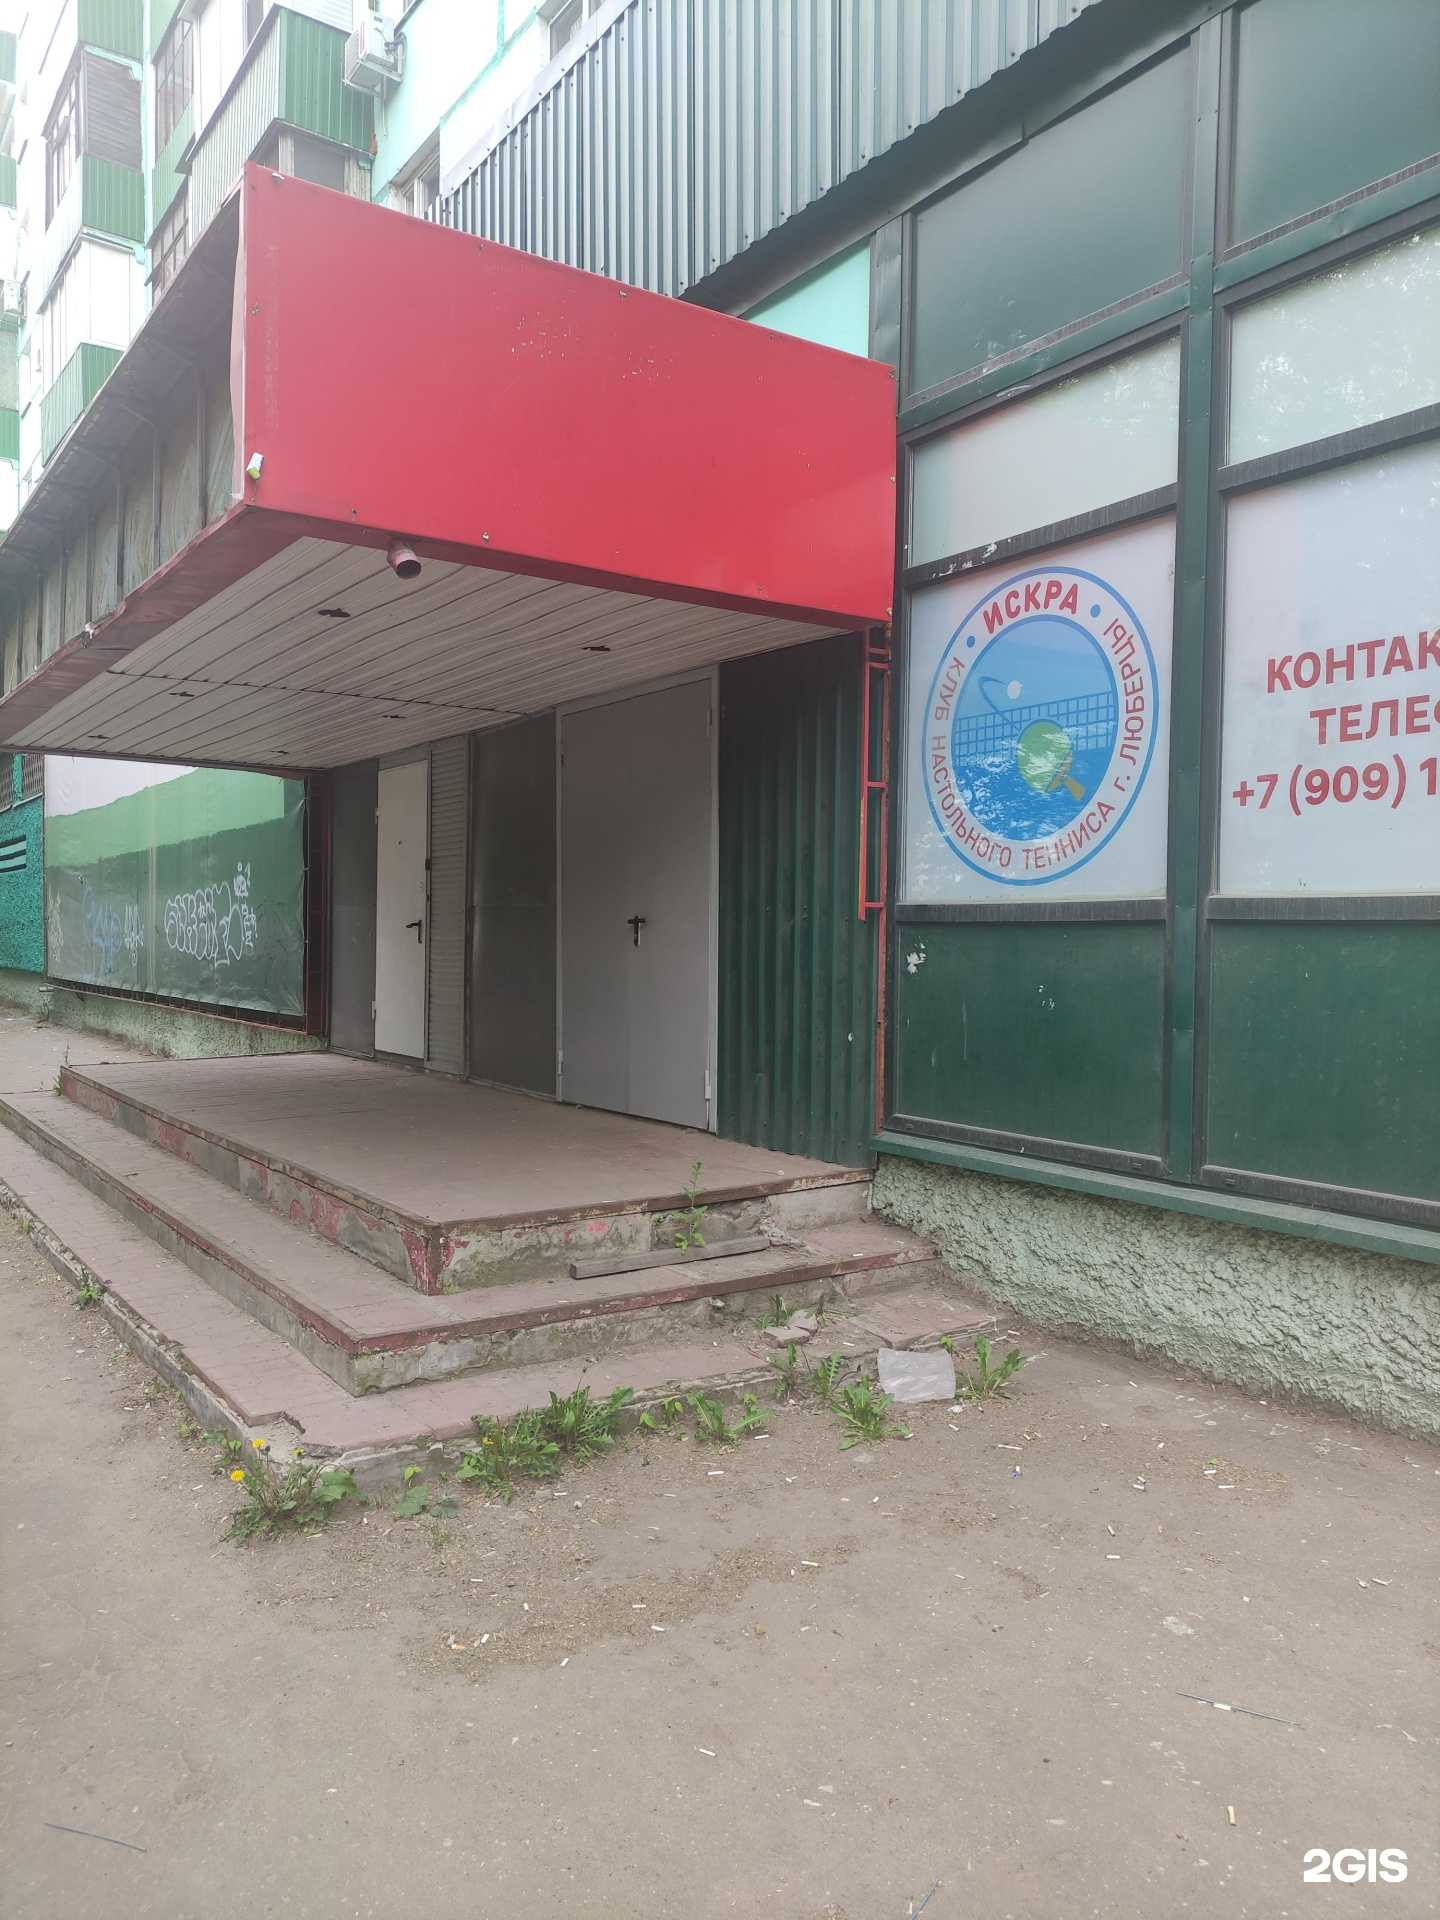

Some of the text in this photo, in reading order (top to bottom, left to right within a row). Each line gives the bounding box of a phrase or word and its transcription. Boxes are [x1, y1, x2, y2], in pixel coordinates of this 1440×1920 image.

[983, 580, 1079, 634] ИСКРА
[935, 656, 966, 721] КЛУБ
[1102, 618, 1145, 766] ЛЮБЕРЦЫ
[1309, 694, 1440, 745] ТЕЛЕ
[931, 735, 1012, 868] НАСТОЛЬНОГО
[1022, 800, 1116, 870] ТЕННИСА
